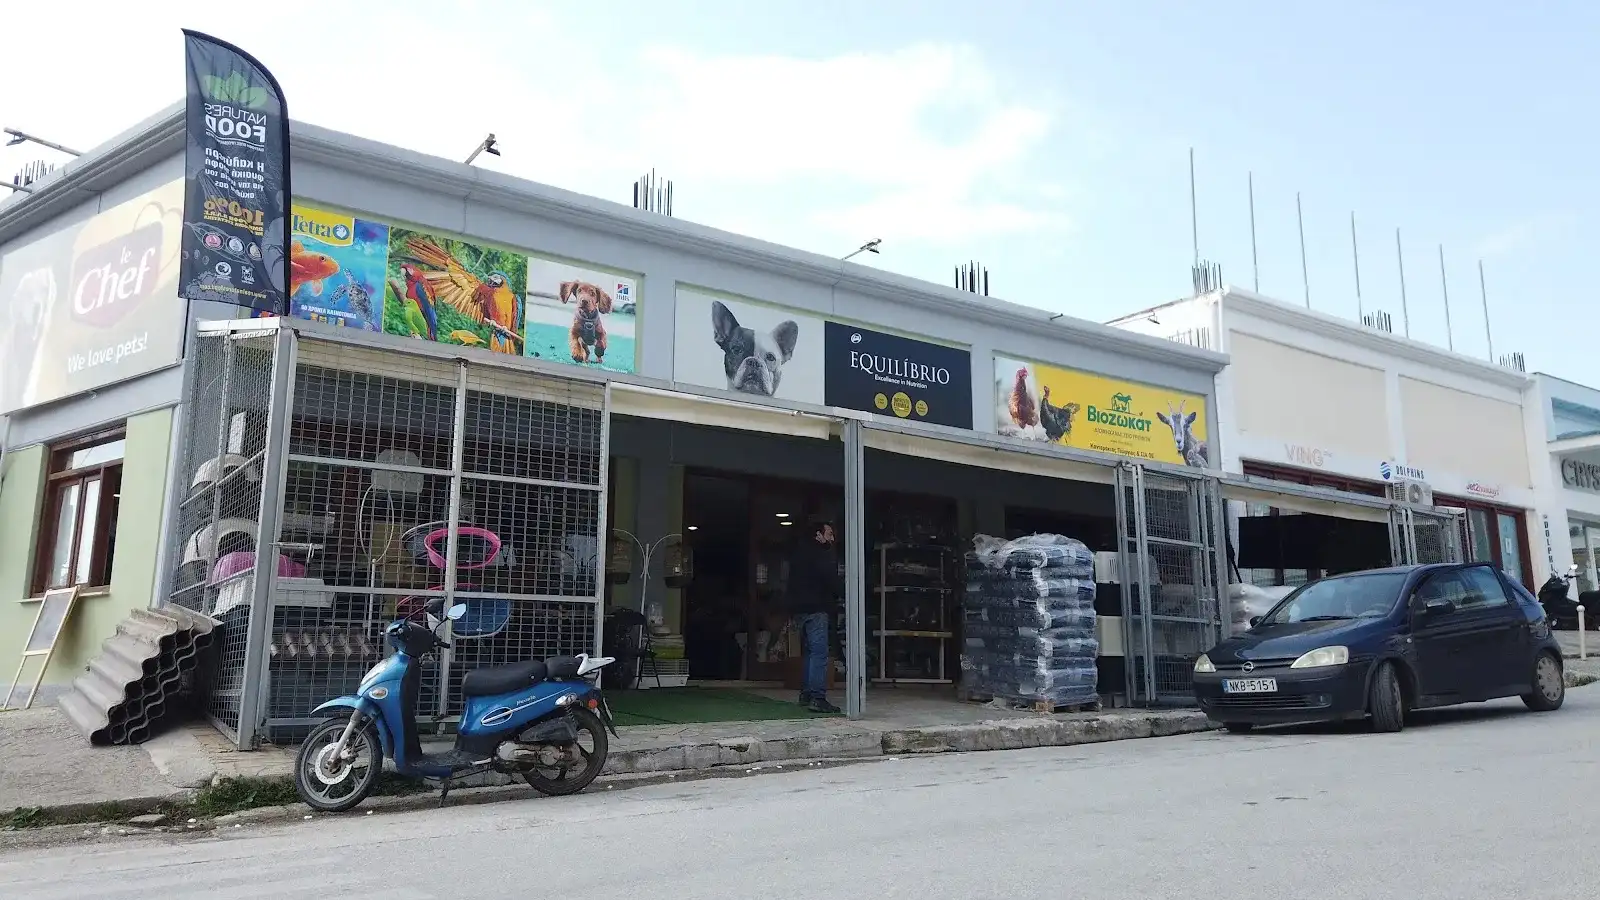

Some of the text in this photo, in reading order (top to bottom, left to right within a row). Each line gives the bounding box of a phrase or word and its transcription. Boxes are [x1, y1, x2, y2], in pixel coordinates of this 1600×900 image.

[291, 213, 332, 238] Tetra
[120, 245, 132, 266] le
[74, 247, 156, 316] Chef
[68, 331, 148, 373] We love pets!
[849, 350, 950, 385] EQUILÍBRIO
[875, 374, 900, 385] Excellence
[906, 380, 928, 389] Nutrition
[1395, 465, 1425, 480] DOLPHINS
